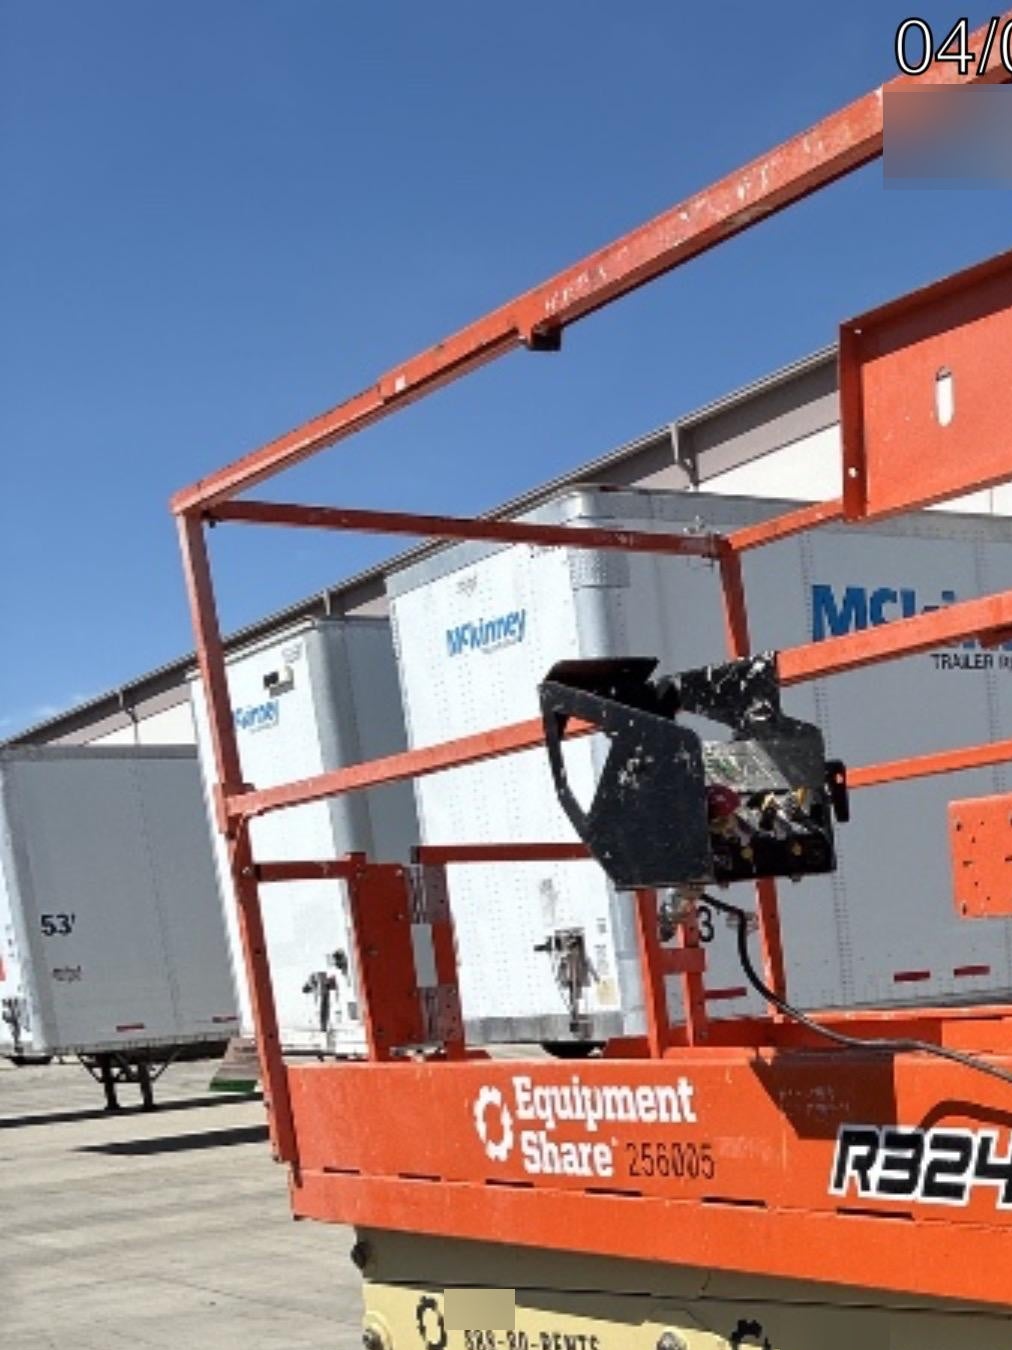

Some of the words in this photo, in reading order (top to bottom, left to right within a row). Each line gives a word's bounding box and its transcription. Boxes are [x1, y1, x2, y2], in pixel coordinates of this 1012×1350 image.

[930, 653, 993, 669] TRAILER
[512, 1075, 698, 1131] Equipment
[520, 1129, 614, 1177] Share
